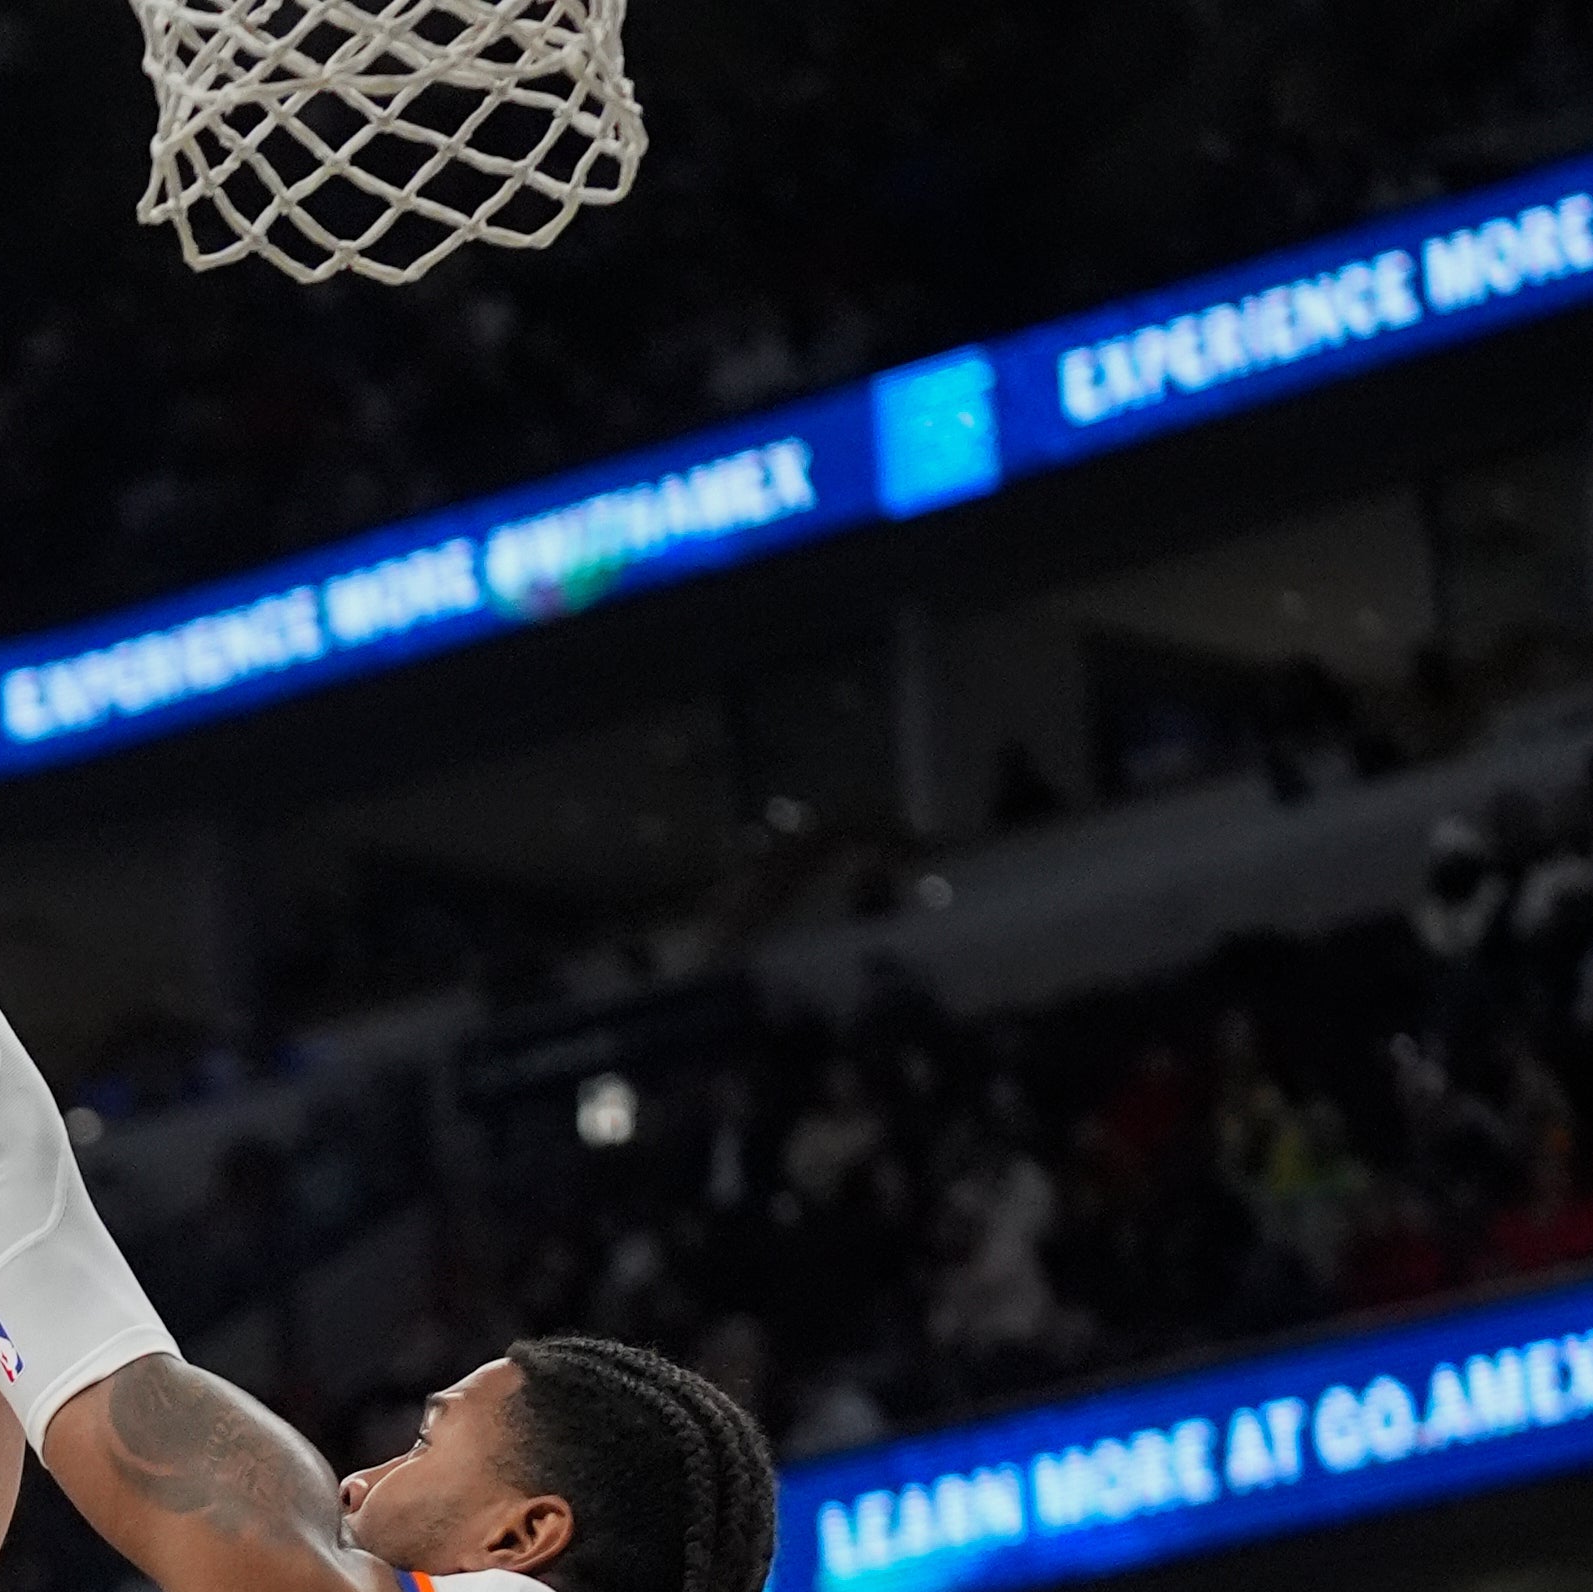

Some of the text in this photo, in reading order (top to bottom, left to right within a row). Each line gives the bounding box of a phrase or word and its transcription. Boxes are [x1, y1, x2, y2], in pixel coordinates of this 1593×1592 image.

[1060, 192, 1593, 425] EXPERIENCE MORE
[2, 586, 323, 740] EXPERIENCE
[324, 537, 481, 648] MORE
[819, 1462, 1025, 1580] LEARN
[1032, 1418, 1218, 1530] MORE
[1226, 1397, 1303, 1491] AT
